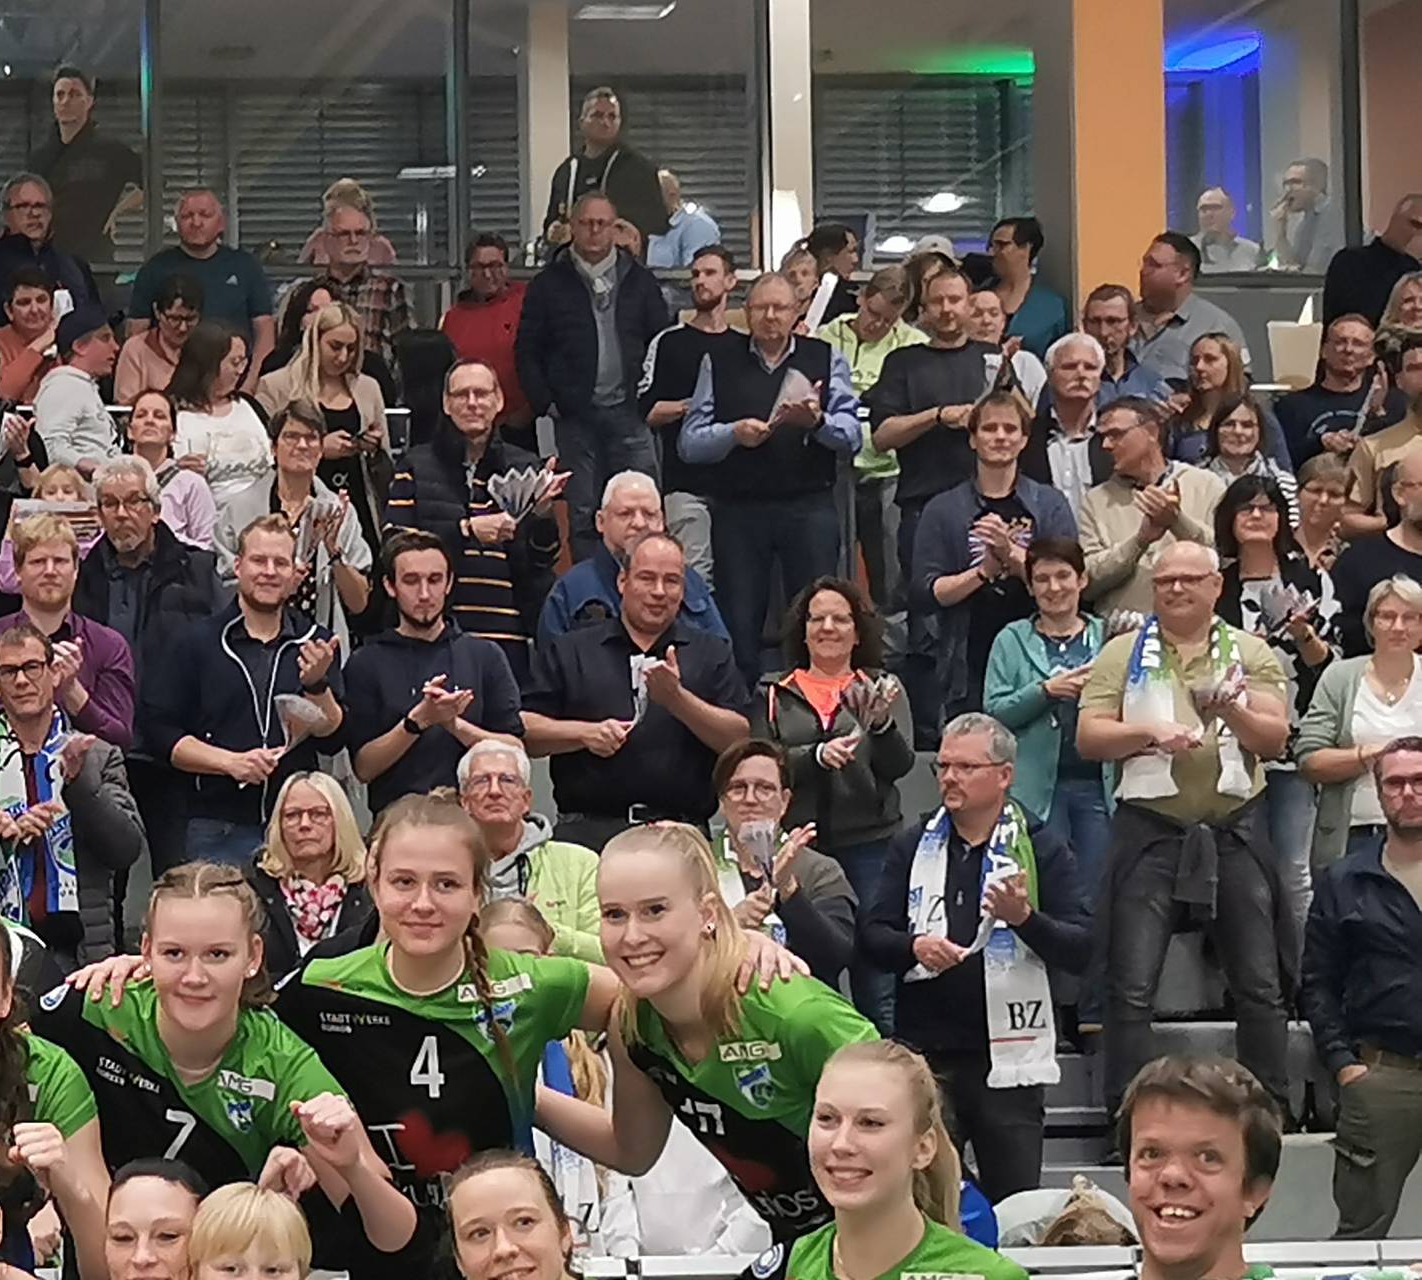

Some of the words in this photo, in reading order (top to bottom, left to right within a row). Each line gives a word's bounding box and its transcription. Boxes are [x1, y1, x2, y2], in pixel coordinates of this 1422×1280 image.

[1007, 1000, 1046, 1031] BZ
[410, 1036, 445, 1099] 4
[165, 1108, 197, 1160] 7
